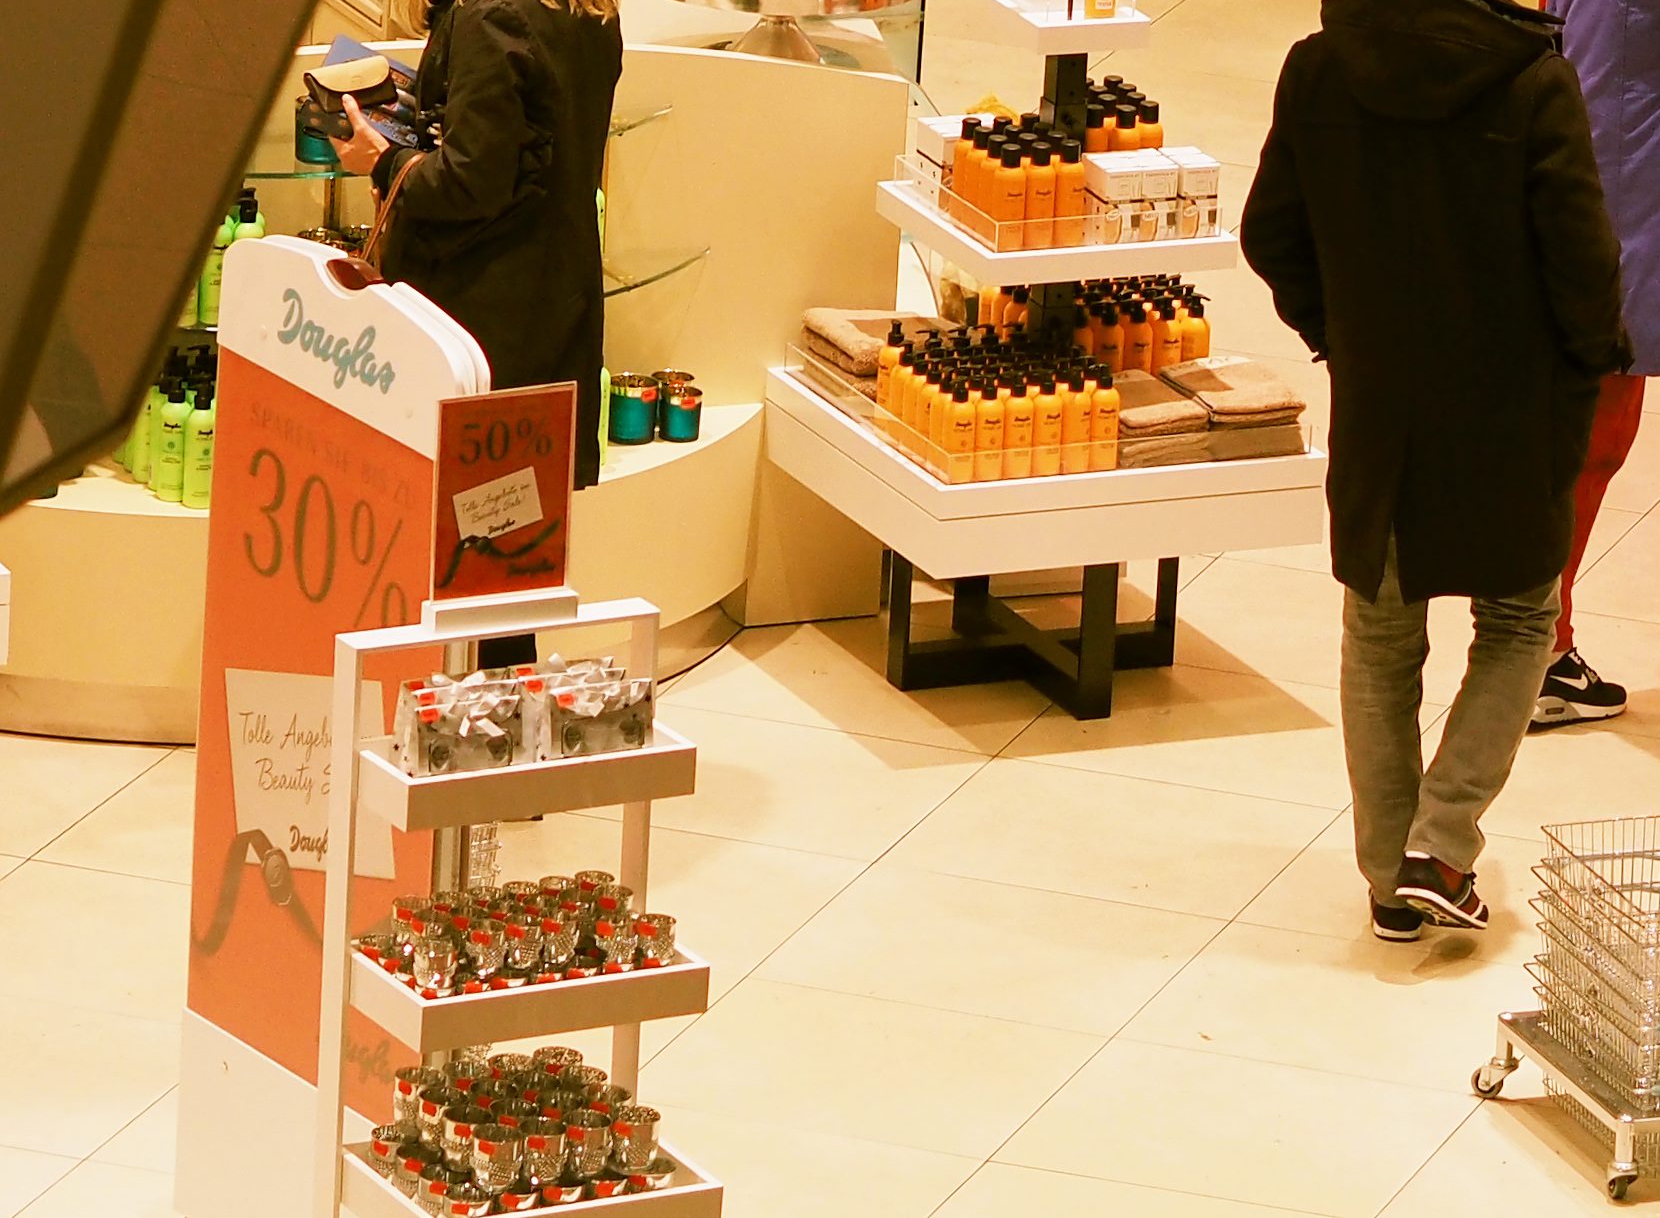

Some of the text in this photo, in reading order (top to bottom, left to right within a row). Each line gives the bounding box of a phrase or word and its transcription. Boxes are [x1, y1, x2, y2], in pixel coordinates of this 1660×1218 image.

[277, 288, 396, 394] Douglas
[458, 418, 553, 466] 50%
[244, 448, 409, 628] 30%
[238, 711, 332, 753] Tolle Angeb
[256, 758, 313, 804] Beauty
[289, 826, 328, 864] Dougl
